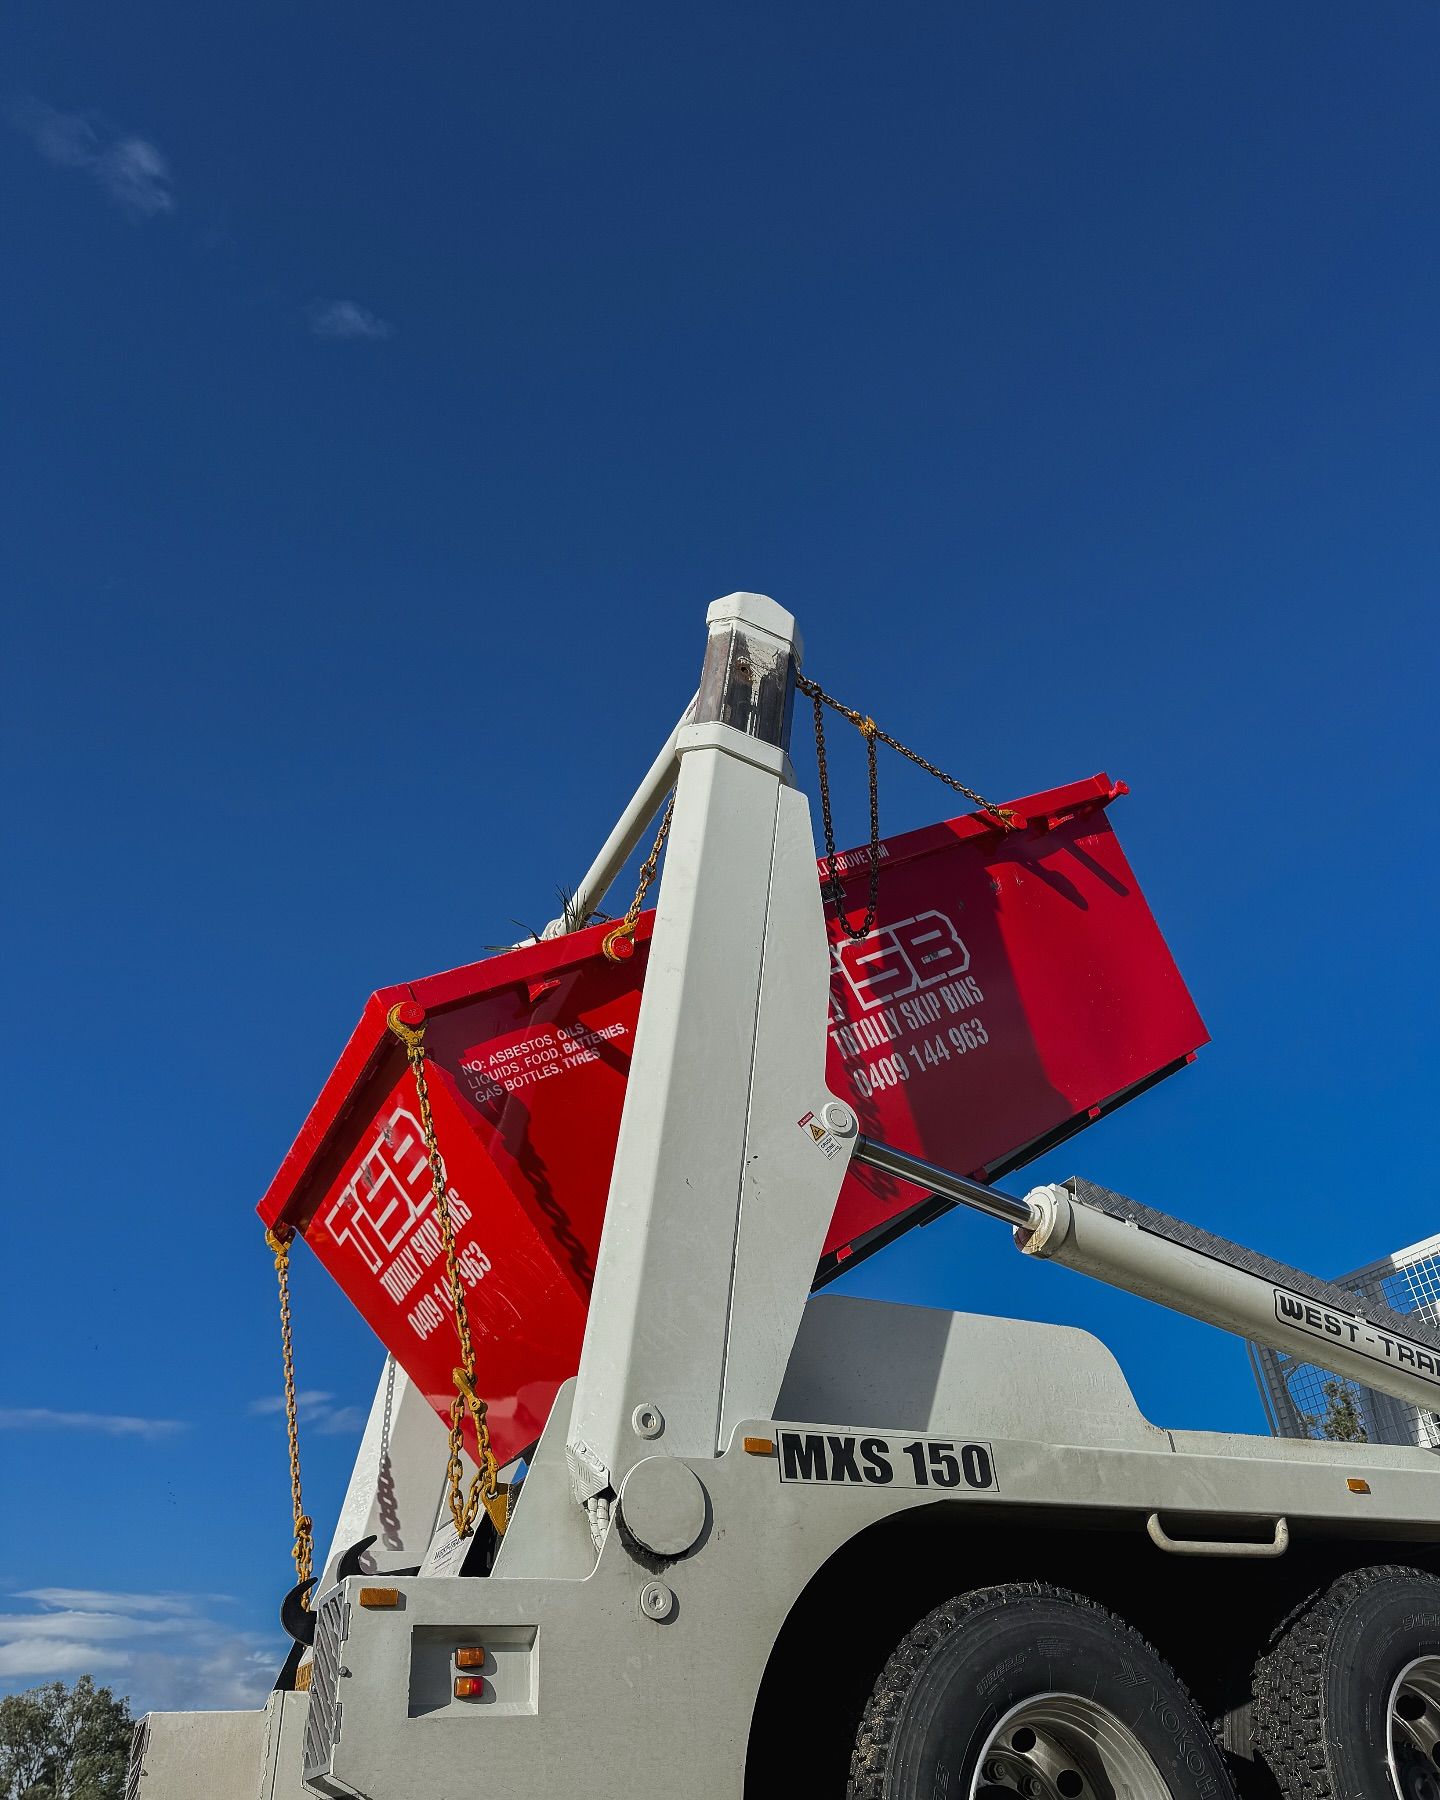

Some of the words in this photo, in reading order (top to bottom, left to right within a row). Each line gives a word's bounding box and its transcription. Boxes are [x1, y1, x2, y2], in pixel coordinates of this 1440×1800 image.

[829, 1009, 903, 1060] TOTALLY
[903, 991, 942, 1030] SKIP
[946, 976, 985, 1015] BINS
[461, 1060, 486, 1076] NO:
[489, 1034, 557, 1066] ASBESTOS,
[468, 1062, 523, 1089] LIQUIDS,
[525, 1047, 563, 1067] FOOD,
[563, 1023, 629, 1054] BATTERIES,
[475, 1083, 504, 1103] GAS
[504, 1064, 563, 1092] BOTTLES,
[562, 1047, 601, 1069] TYRES
[852, 1052, 910, 1098] 0409
[909, 1034, 950, 1073] 144
[948, 1017, 989, 1055] 963
[379, 1245, 424, 1306] TOTALLY
[410, 1218, 443, 1267] SKIP
[407, 1294, 445, 1341] 0409
[456, 1240, 492, 1287] 963
[781, 1433, 894, 1484] MXS
[902, 1441, 993, 1489] 150
